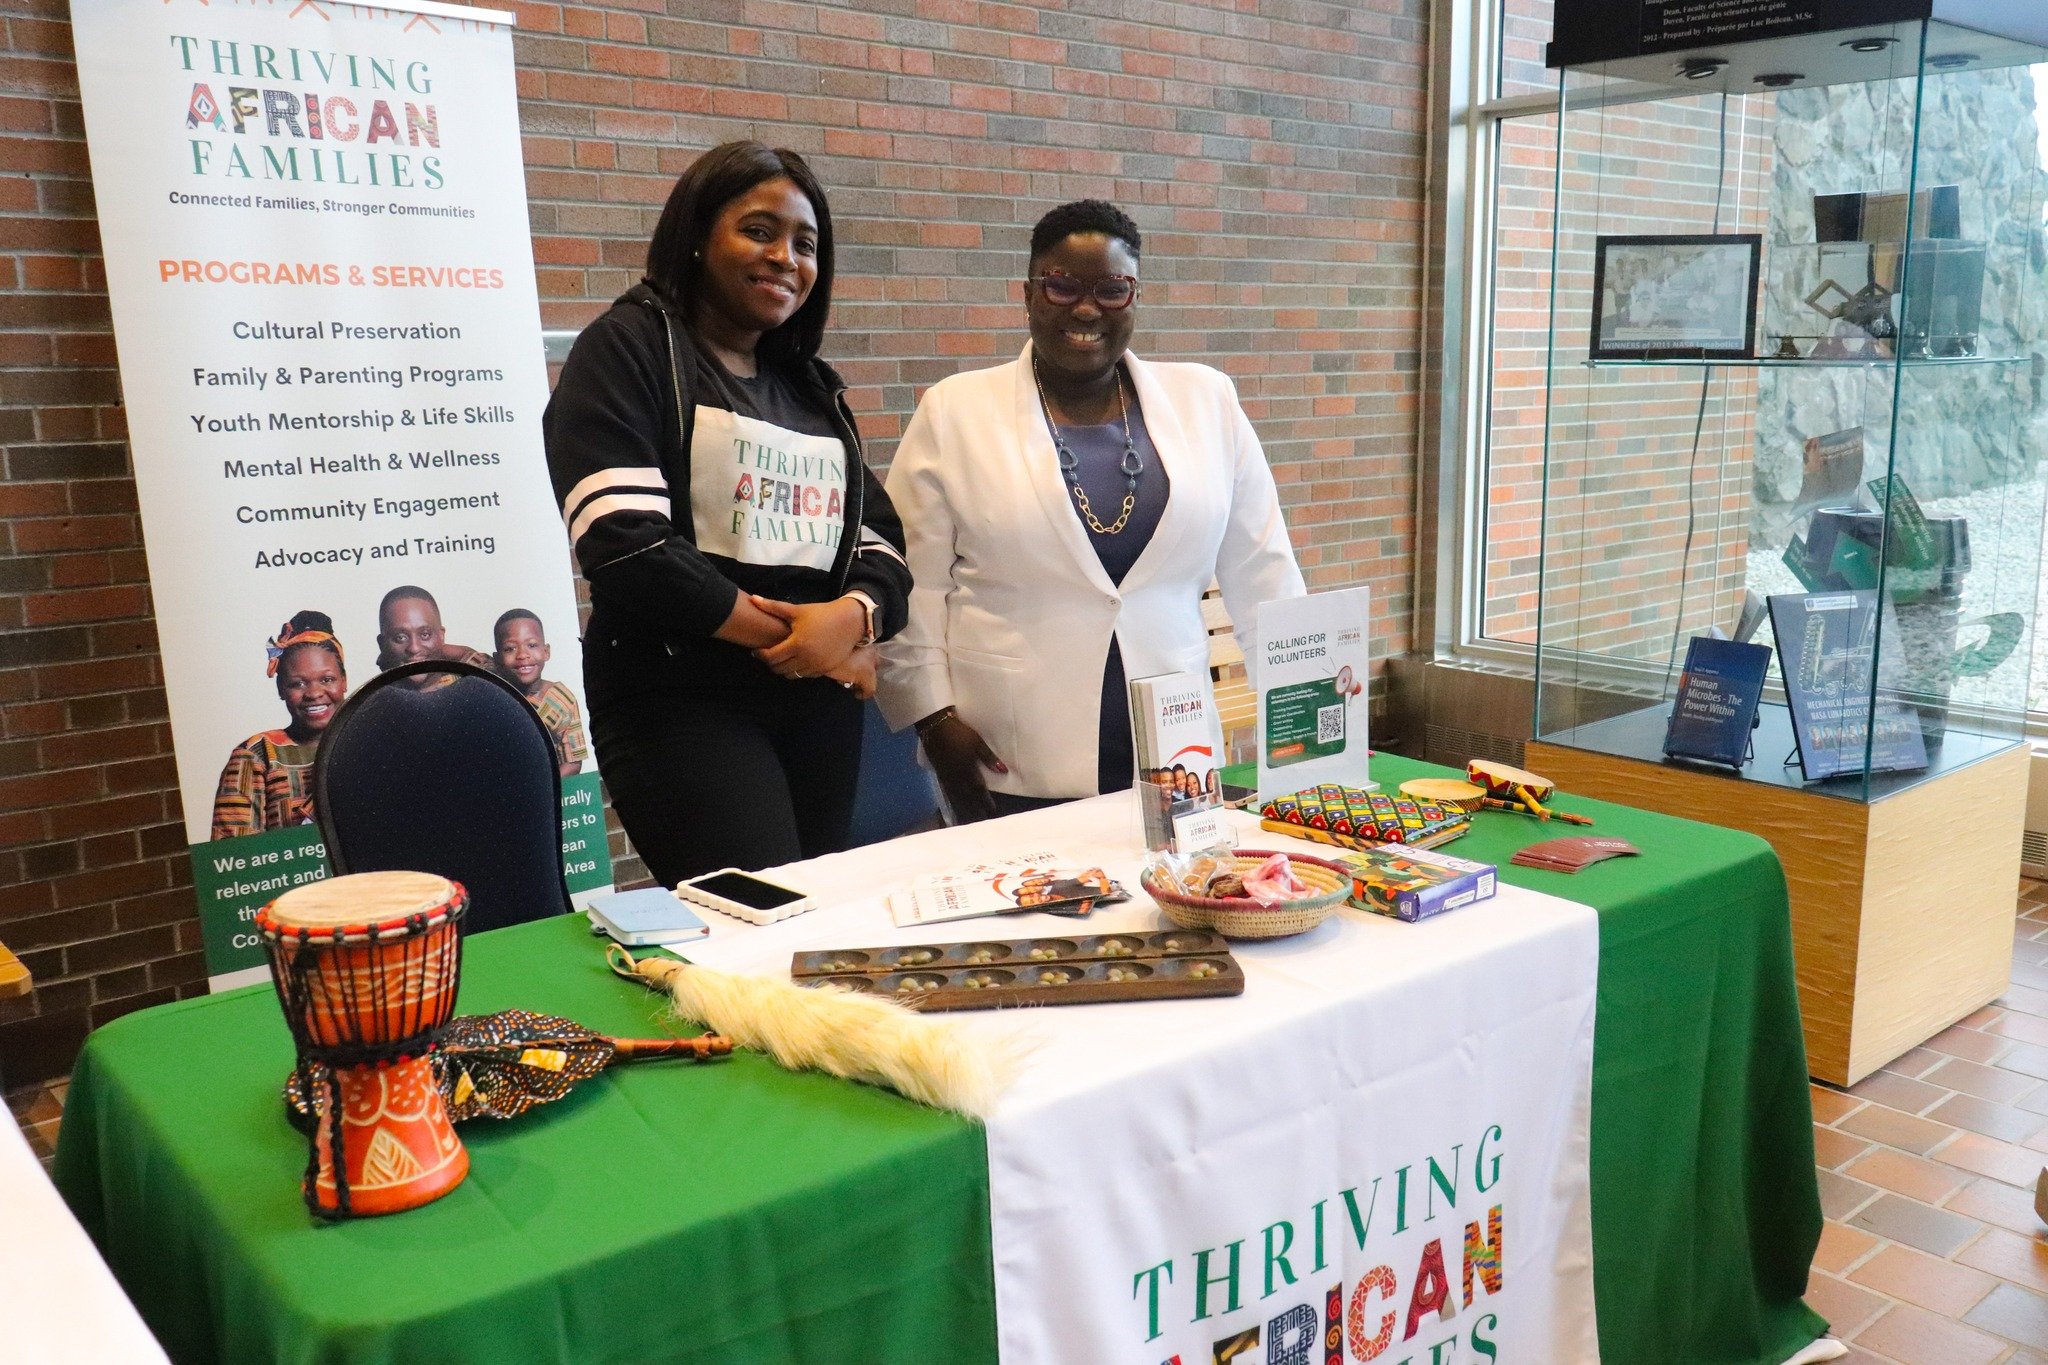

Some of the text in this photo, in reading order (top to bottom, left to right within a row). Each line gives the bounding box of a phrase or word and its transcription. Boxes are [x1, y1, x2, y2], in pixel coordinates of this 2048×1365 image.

[1663, 29, 1692, 41] Prepared
[1693, 27, 1702, 36] by
[1737, 20, 1750, 30] par
[1750, 19, 1764, 27] Luc
[169, 35, 433, 94] THRIVING
[185, 82, 441, 148] AFRICAN
[188, 138, 445, 190] FAMILIES
[169, 191, 476, 219] Connected Families, Stronger Communities
[159, 260, 505, 289] PROGRAMS & SERVICES
[232, 321, 462, 341] Cultural Preservation
[193, 365, 504, 391] Family & Parenting Programs
[191, 405, 515, 433] Youth Mentorship & Life Skills
[224, 449, 501, 479] Mental Health & Wellness
[733, 438, 842, 481] THRIVIN
[236, 490, 501, 525] Community Engagement
[732, 472, 847, 521] AFRICA
[731, 509, 842, 549] FAMILIE
[255, 534, 495, 569] Advocacy and Training
[1267, 632, 1326, 651] CALLING FOR
[1267, 646, 1326, 665] VOLUNTEERS
[1160, 690, 1201, 705] THRIVING
[1686, 688, 1722, 703] Microbes
[1728, 694, 1743, 706] The
[1690, 677, 1718, 690] Human
[1162, 700, 1202, 716] AFRICAN
[1162, 711, 1203, 727] FAMILIES
[1684, 699, 1736, 717] Power Within
[214, 857, 246, 873] We
[251, 852, 279, 866] are
[284, 849, 294, 860] a
[298, 843, 326, 858] reg
[216, 873, 289, 900] relevant
[293, 864, 326, 884] and
[582, 813, 597, 826] to
[564, 860, 597, 876] Area
[1132, 1124, 1504, 1344] THRIVING
